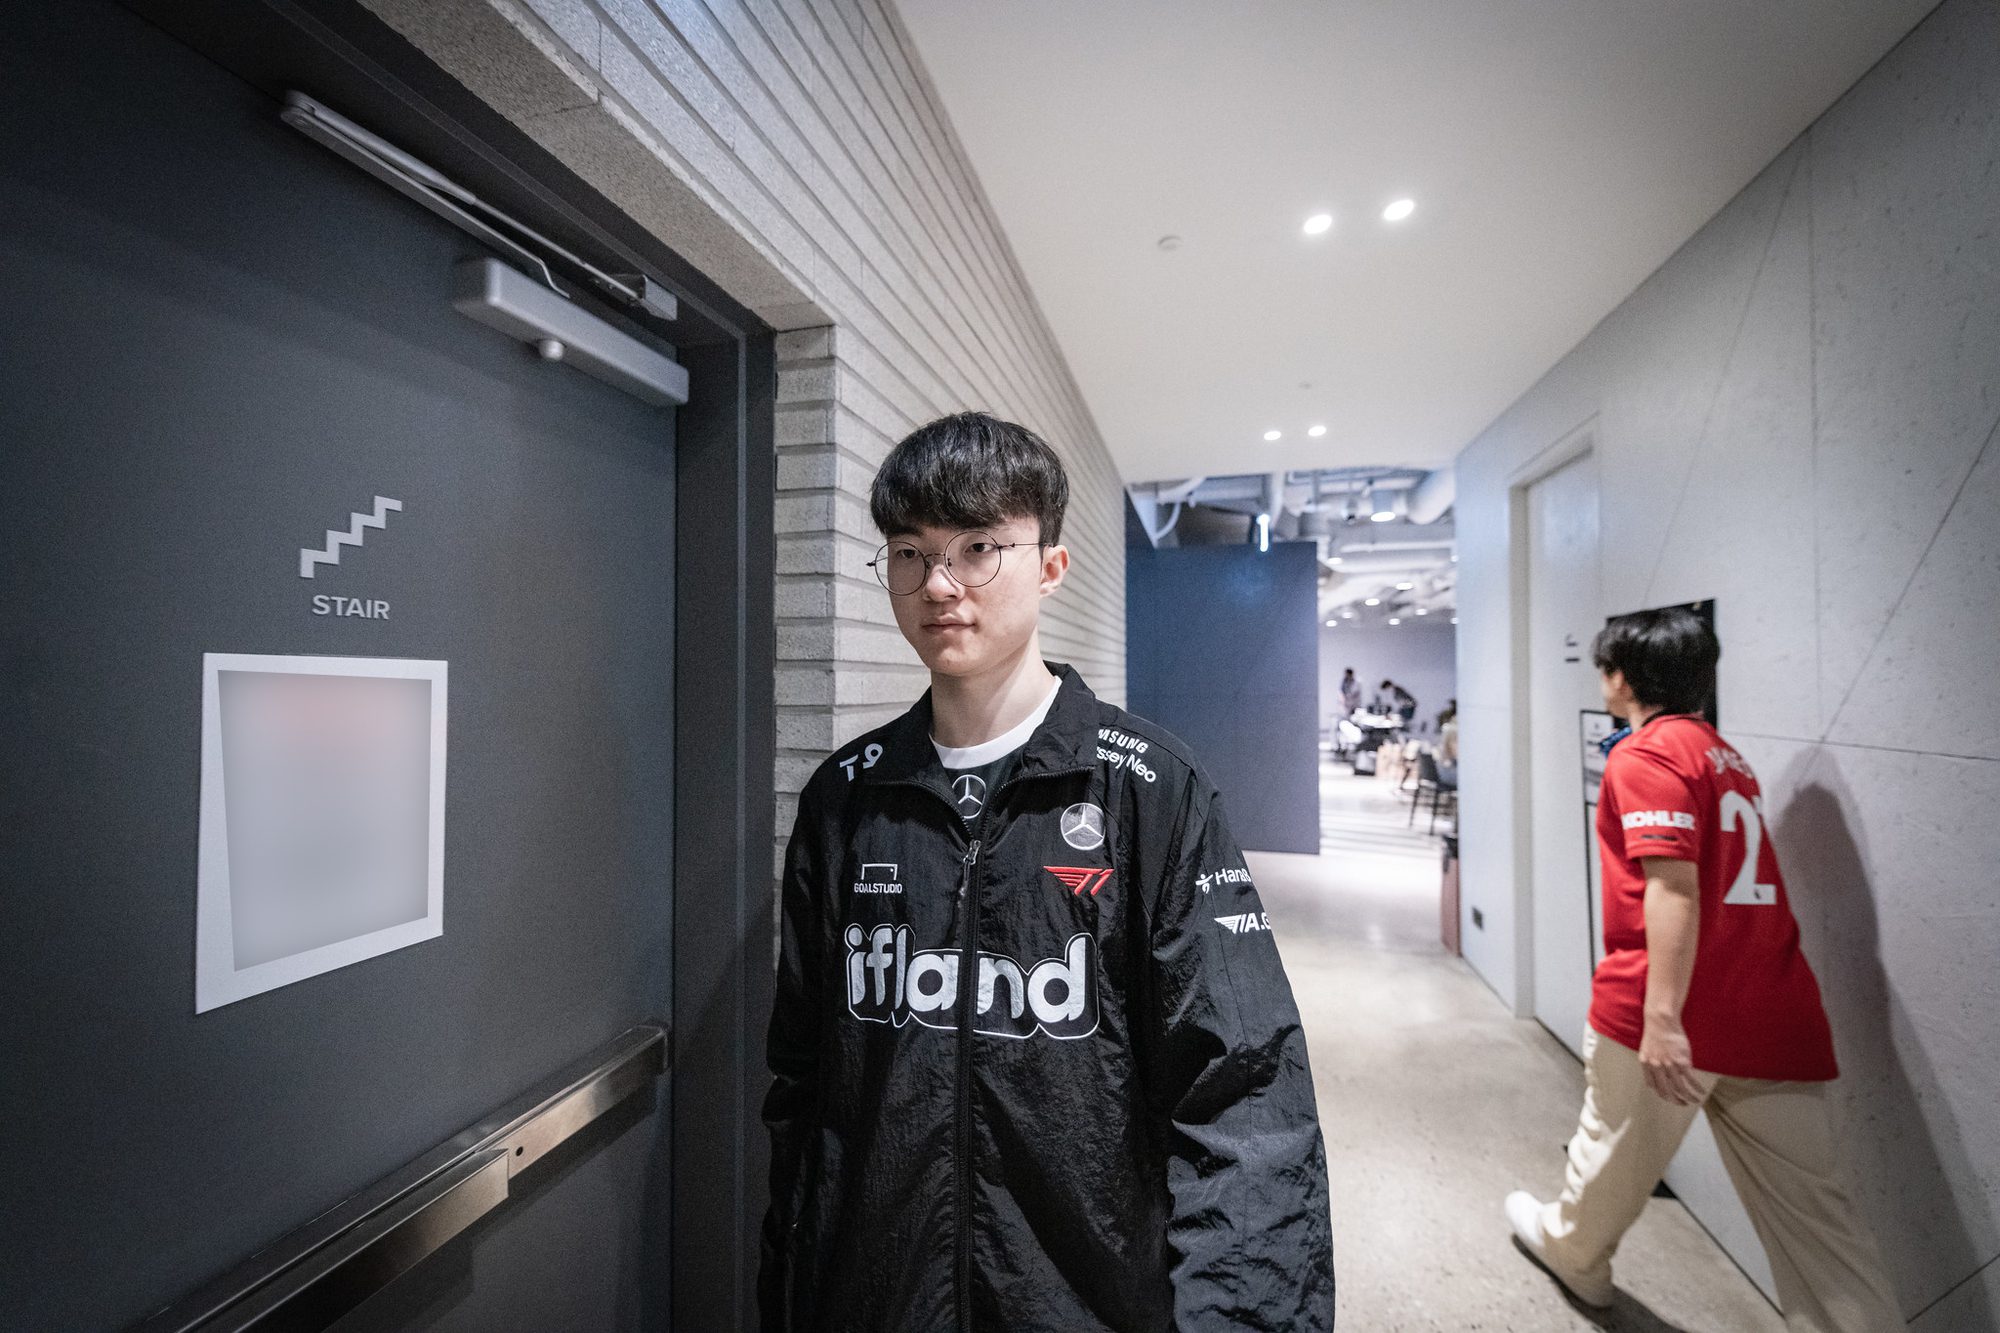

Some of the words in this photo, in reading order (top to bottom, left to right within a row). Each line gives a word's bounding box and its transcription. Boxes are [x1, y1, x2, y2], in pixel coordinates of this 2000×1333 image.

[312, 594, 390, 620] STAIR
[1096, 746, 1128, 769] ssey
[1125, 753, 1157, 783] Neo
[1719, 789, 1777, 906] 2
[853, 882, 903, 894] GOALSTUDIO
[847, 926, 1087, 1025] ifland
